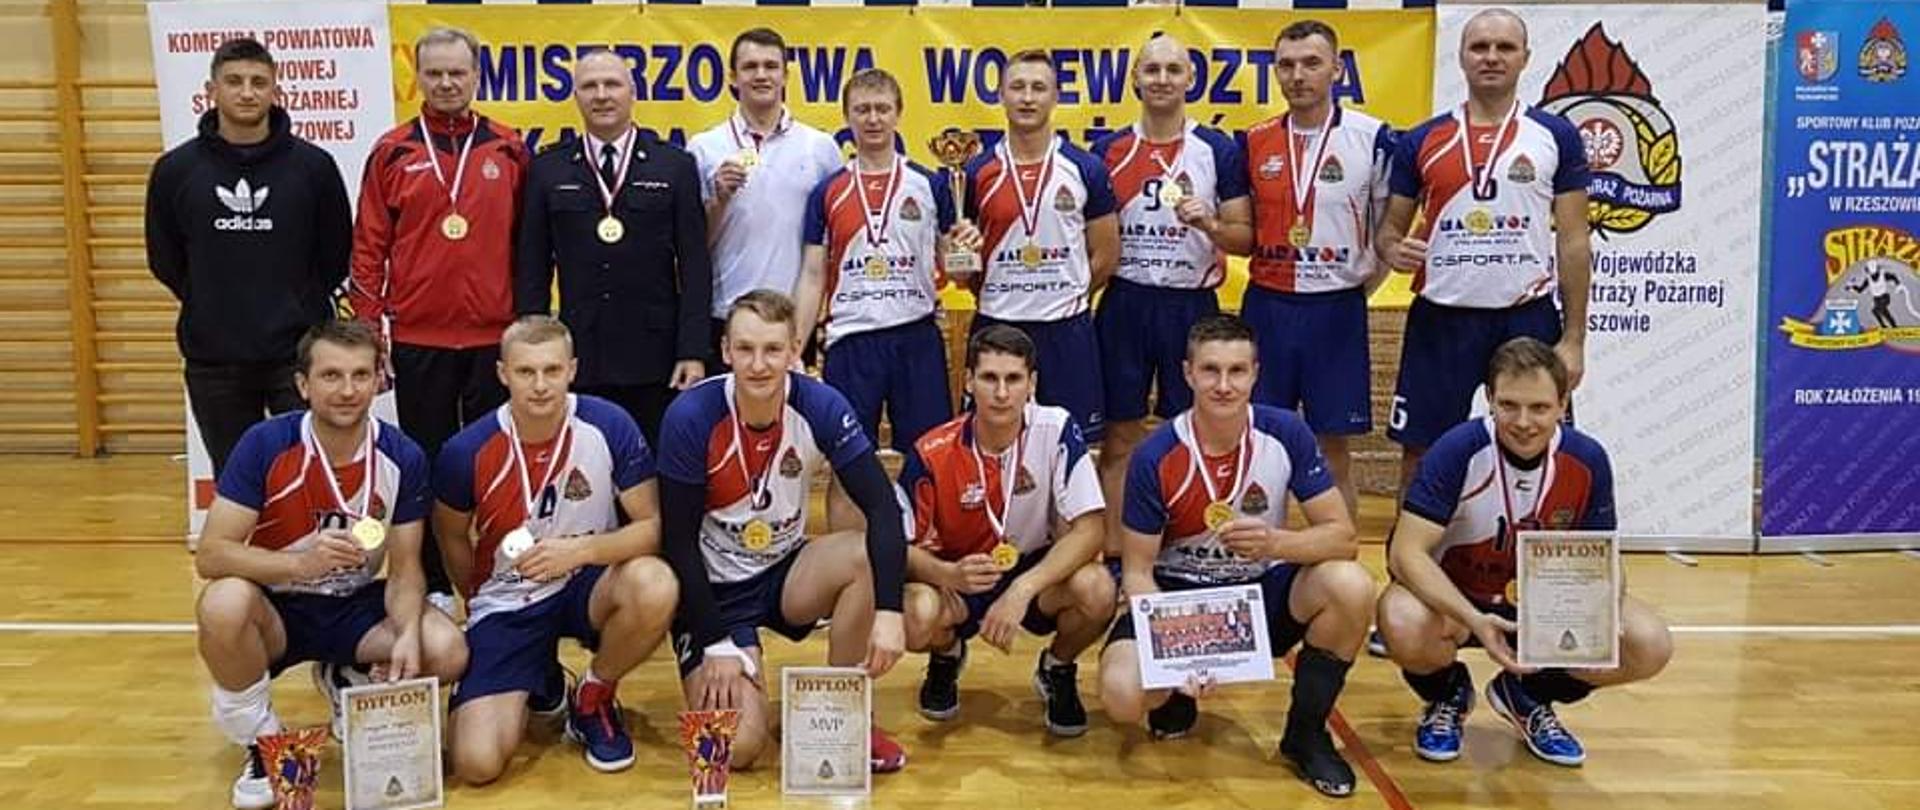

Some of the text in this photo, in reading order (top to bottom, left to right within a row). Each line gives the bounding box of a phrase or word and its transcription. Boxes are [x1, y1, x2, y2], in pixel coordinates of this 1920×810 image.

[265, 27, 374, 50] POWIATOWA
[276, 85, 360, 111] OŻARNEJ
[1796, 115, 1859, 130] SPORTOWY
[1861, 116, 1892, 130] KLUB
[1829, 196, 1842, 212] W
[214, 215, 273, 231] adidas
[1591, 279, 1725, 308] traży Pożarnej
[1588, 309, 1651, 333] szowie
[1795, 389, 1823, 405] ROK
[1826, 387, 1902, 405] ZAŁOŻENIA
[1390, 394, 1409, 431] 6
[1532, 542, 1606, 558] DYPLOM
[795, 677, 864, 694] DYPLOM
[356, 690, 427, 712] DYPLOM
[808, 716, 845, 732] MVP
